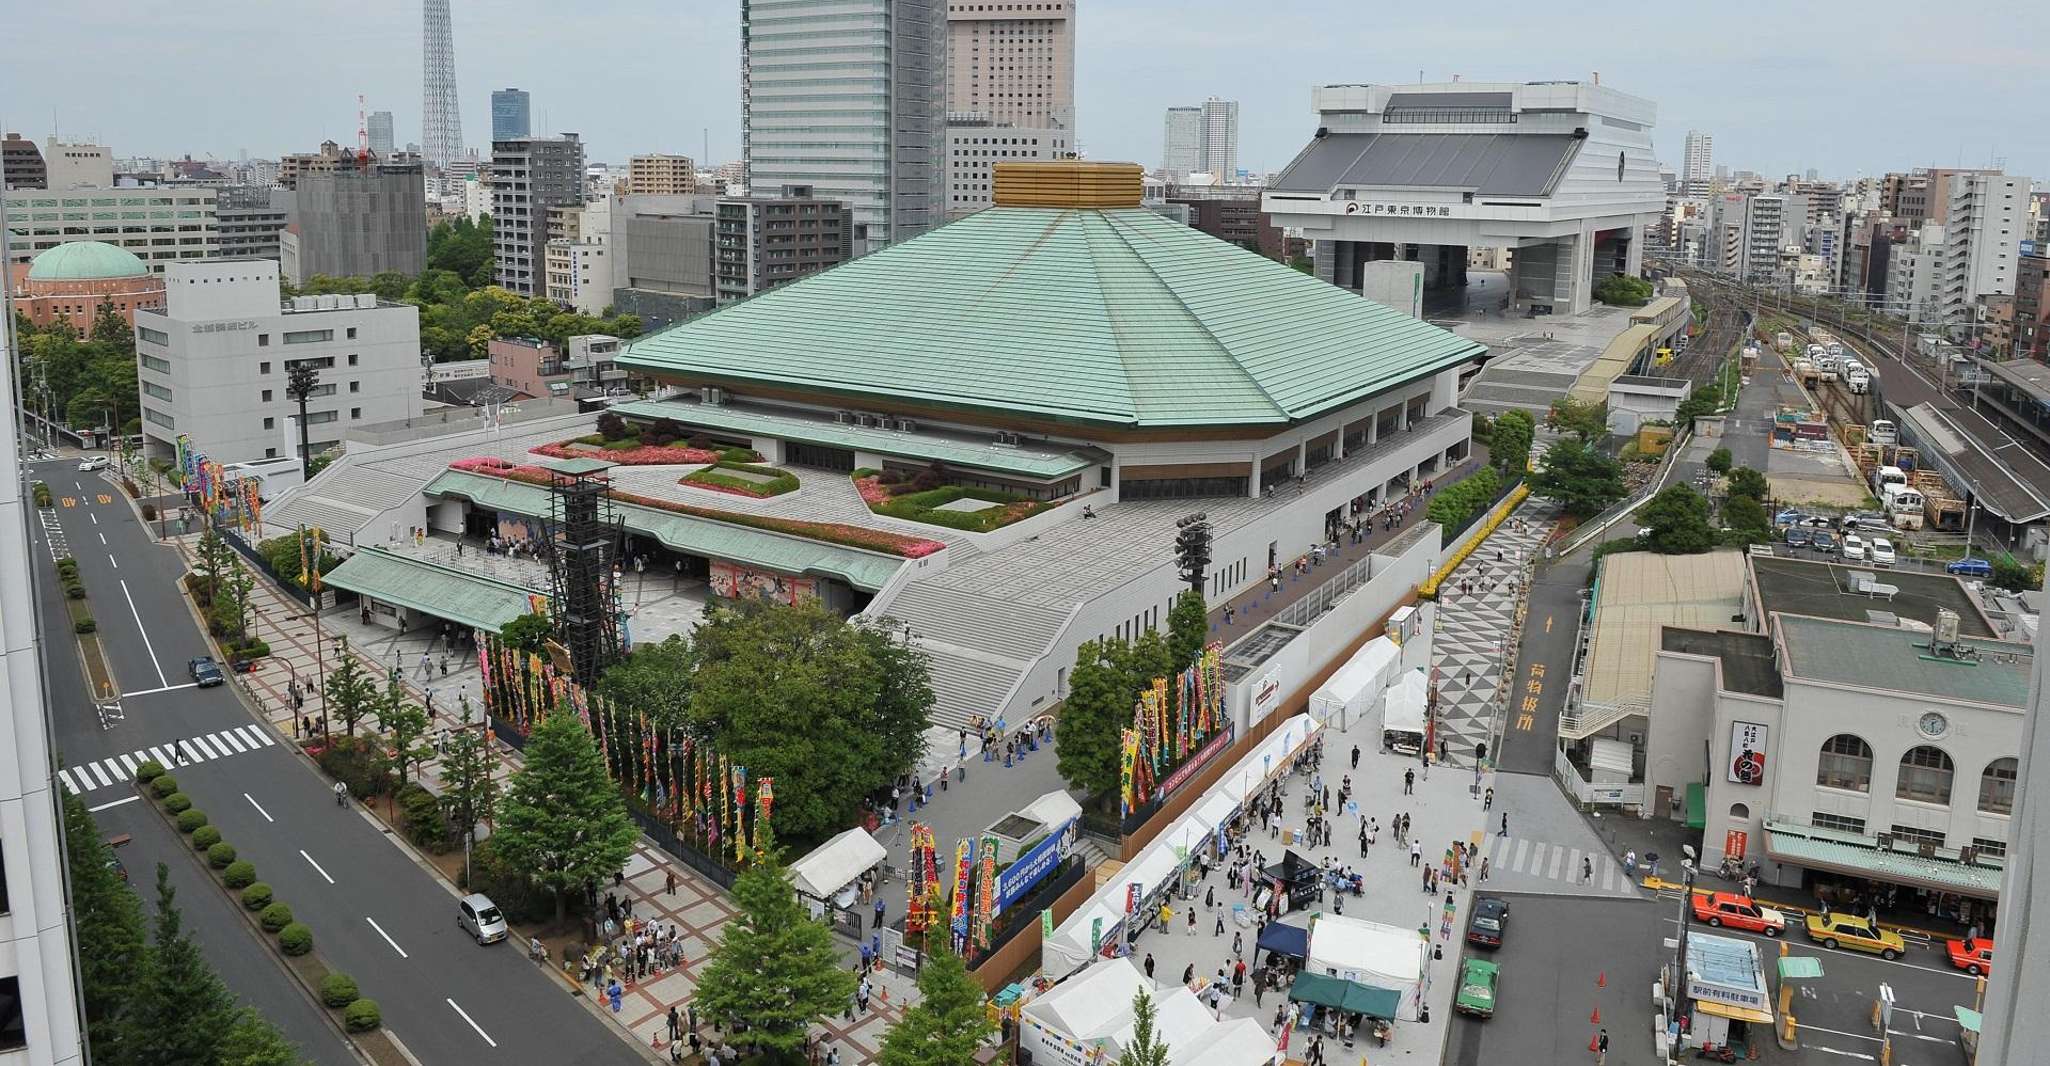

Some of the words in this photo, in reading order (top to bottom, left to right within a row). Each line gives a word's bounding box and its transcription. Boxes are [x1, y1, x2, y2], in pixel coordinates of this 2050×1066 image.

[1361, 204, 1450, 217] 江戸東京博物館
[1516, 663, 1546, 731] 荷物扱所
[1692, 985, 1759, 1005] 駅前有料駐車場
